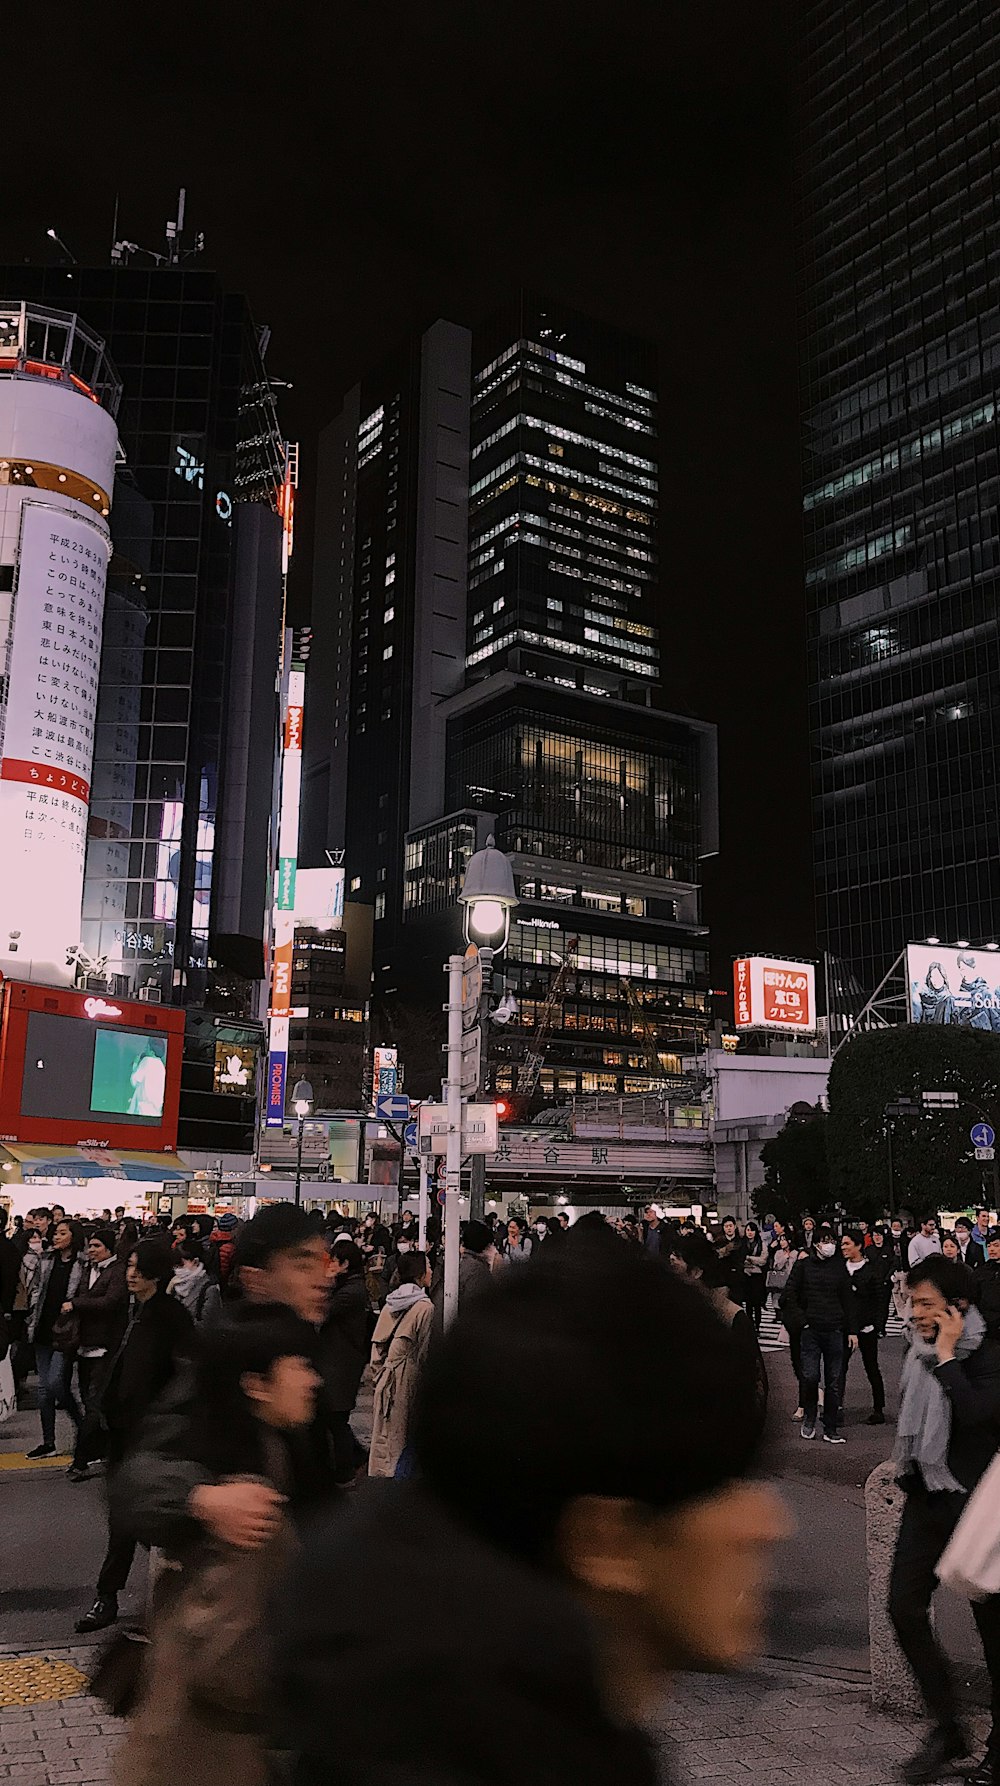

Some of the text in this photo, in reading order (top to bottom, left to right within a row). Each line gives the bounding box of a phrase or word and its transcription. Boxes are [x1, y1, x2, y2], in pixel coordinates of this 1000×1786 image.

[764, 972, 807, 990] ほけんの
[770, 1007, 803, 1020] グループ
[271, 1063, 283, 1105] PROMISE
[493, 1144, 607, 1164] 渋谷駅
